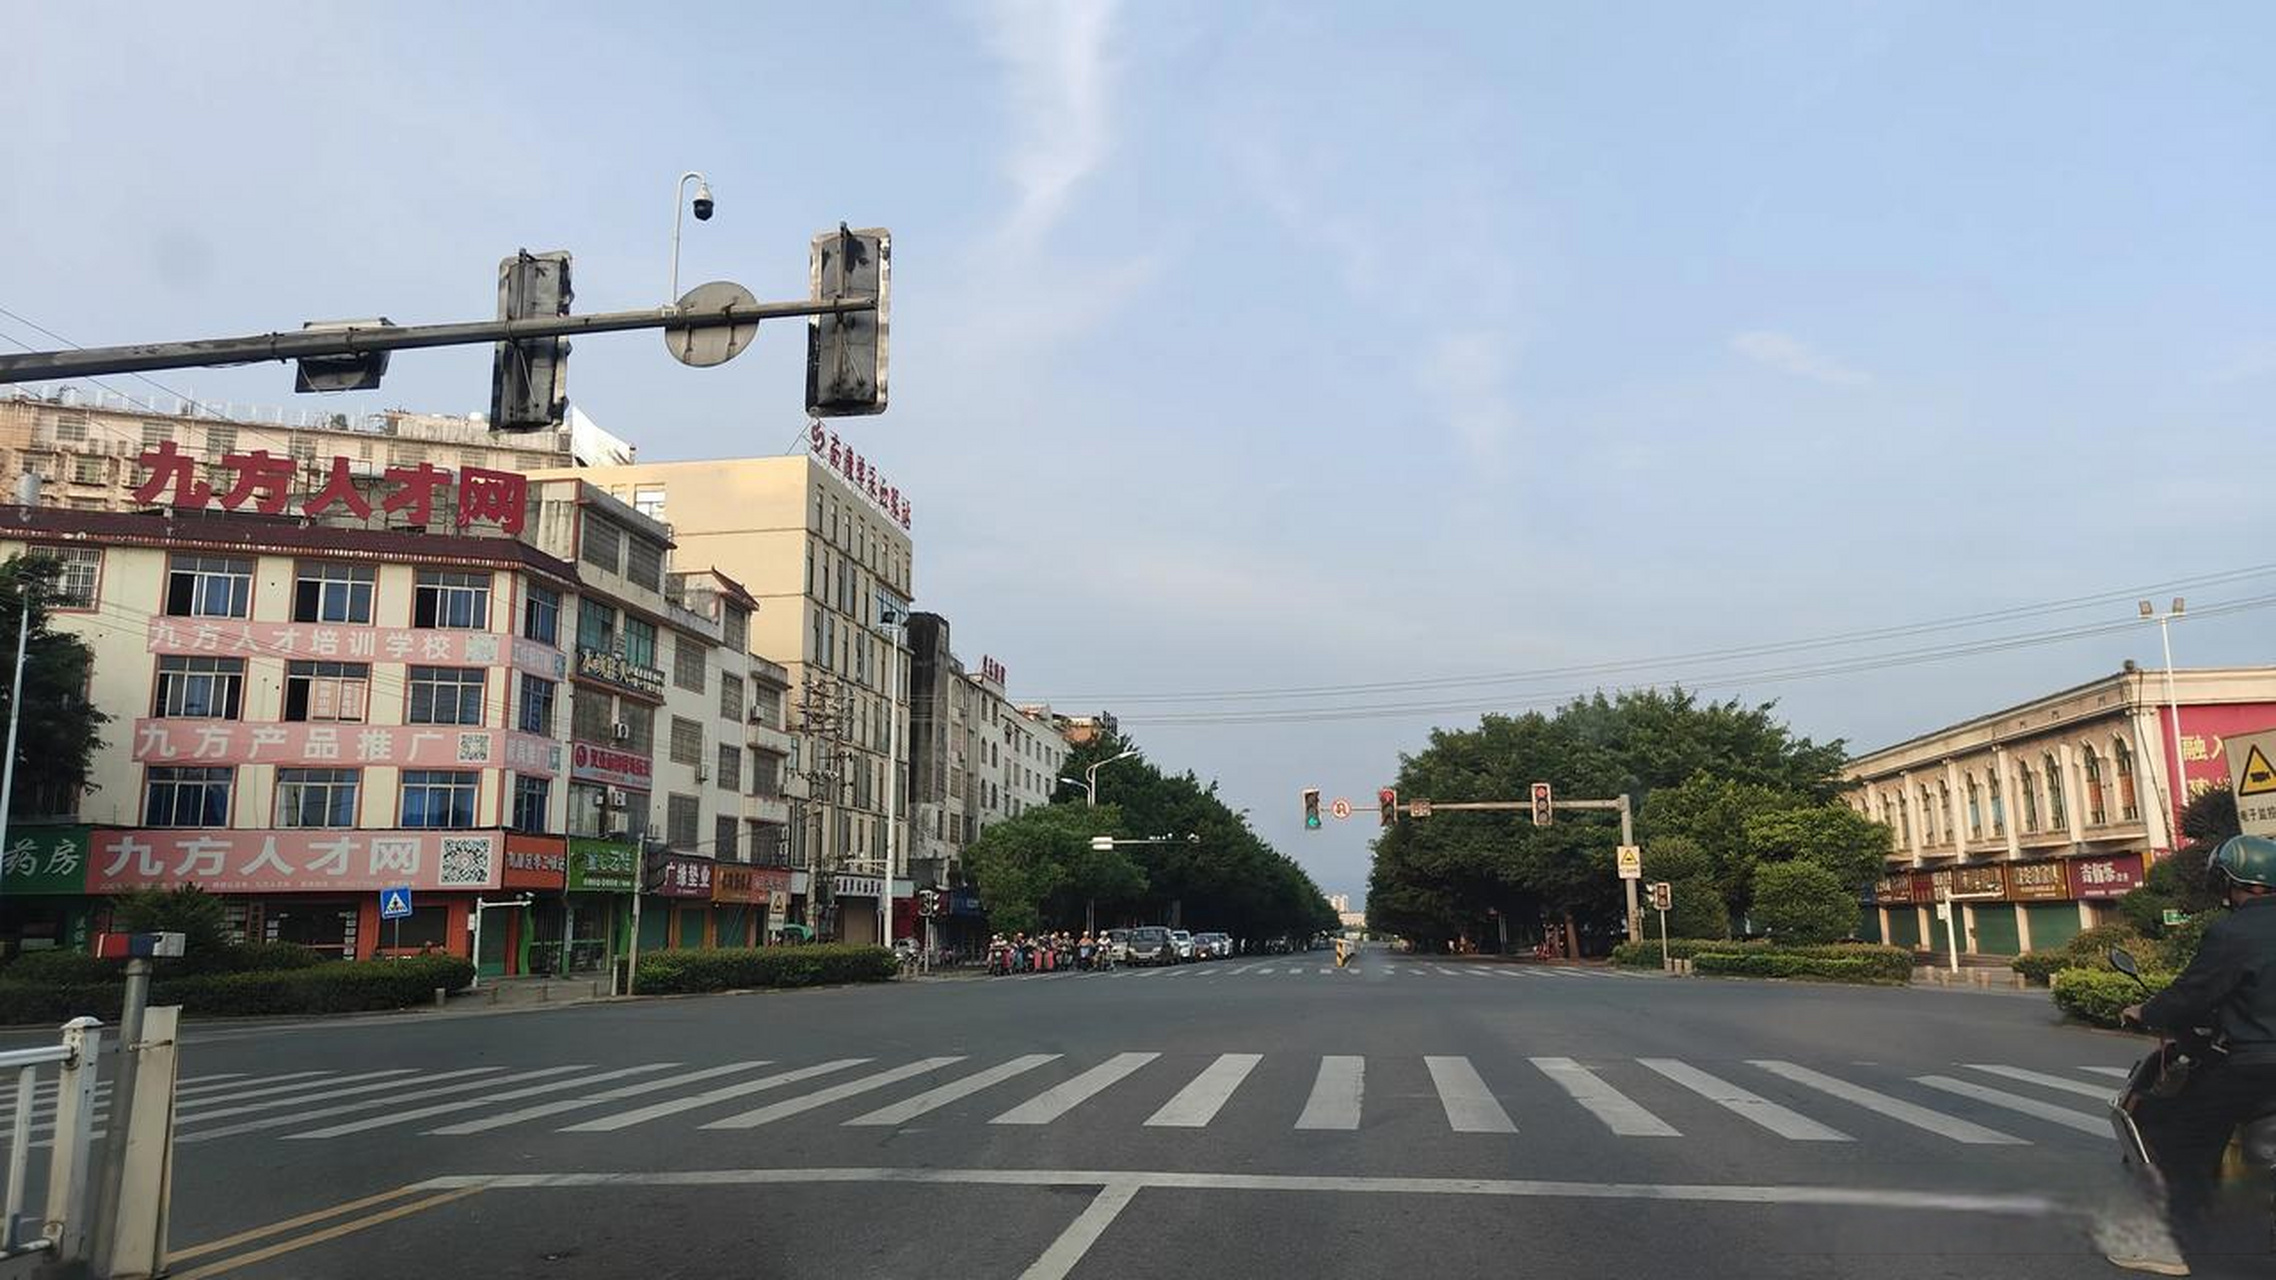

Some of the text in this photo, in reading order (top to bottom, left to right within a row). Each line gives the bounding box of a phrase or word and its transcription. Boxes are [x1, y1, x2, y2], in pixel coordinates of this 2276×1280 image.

[133, 440, 527, 534] 九方人才网
[150, 621, 452, 661] 九方人才培训学校
[139, 724, 444, 763] 九方产品推广
[103, 837, 422, 876] 九方人才网
